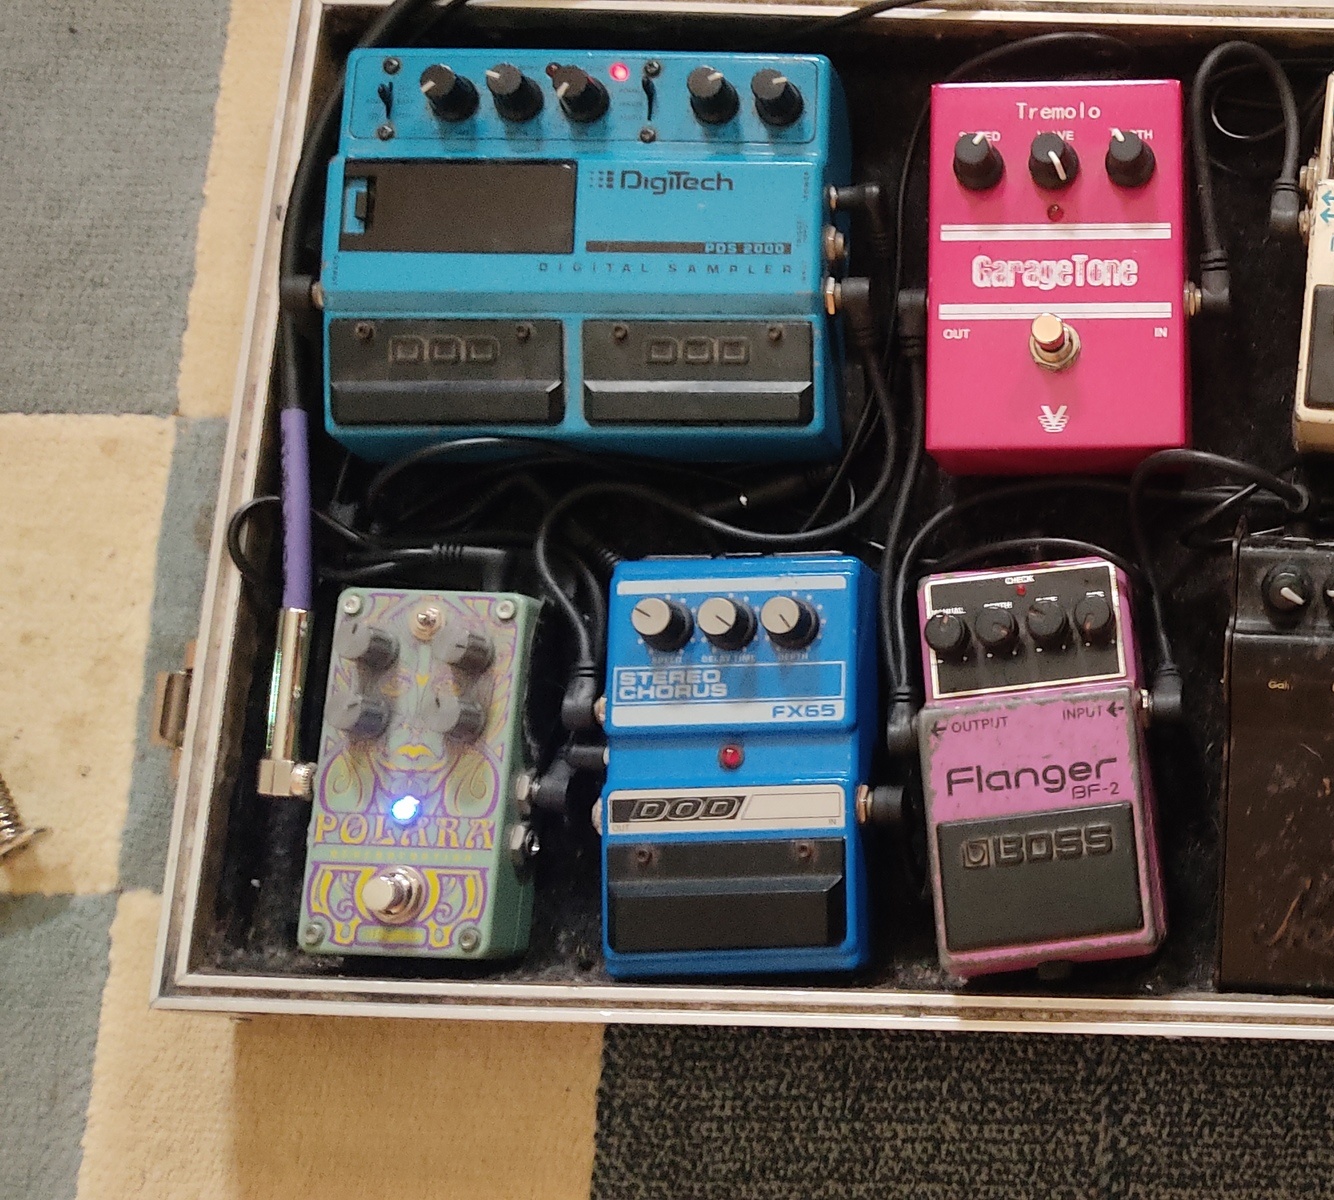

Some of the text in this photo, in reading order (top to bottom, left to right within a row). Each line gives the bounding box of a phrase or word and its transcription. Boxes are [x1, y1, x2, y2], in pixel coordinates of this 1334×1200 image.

[1016, 103, 1101, 120] Tremolo
[620, 170, 734, 194] DigiTech
[705, 243, 784, 254] PDS 2000
[539, 263, 650, 274] DIGITAL
[668, 264, 794, 274] SAMPLER
[972, 254, 1138, 291] GarageTone
[943, 329, 970, 339] OUT
[1154, 328, 1168, 337] IN
[620, 669, 721, 686] STEREO
[619, 683, 727, 700] CHORUS
[772, 704, 836, 718] FX65
[1063, 706, 1102, 721] INPUT
[951, 716, 1009, 733] OUTPUT
[946, 758, 1117, 796] Flanger
[1071, 782, 1120, 800] BF-2
[629, 797, 742, 822] DOD
[314, 812, 495, 849] POLARA
[994, 823, 1113, 867] BOSS
